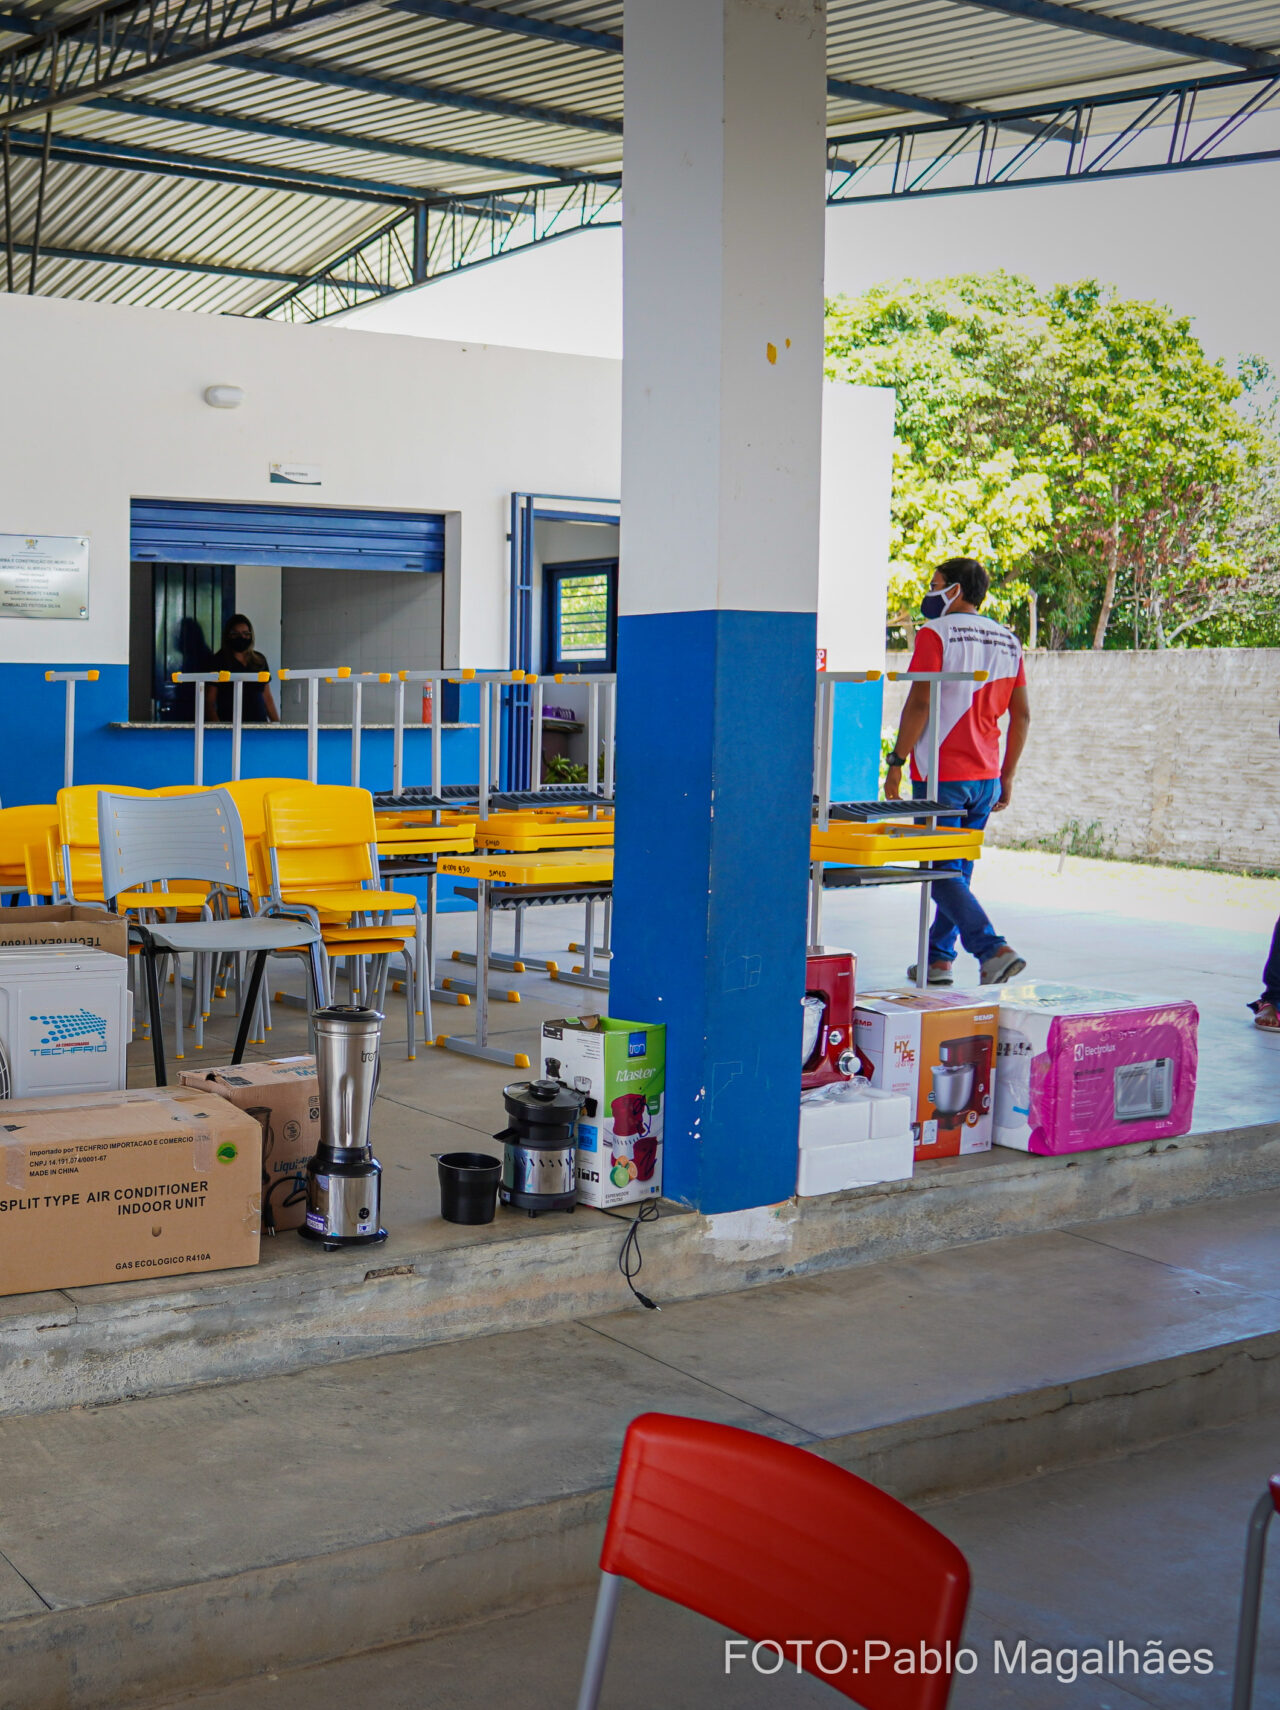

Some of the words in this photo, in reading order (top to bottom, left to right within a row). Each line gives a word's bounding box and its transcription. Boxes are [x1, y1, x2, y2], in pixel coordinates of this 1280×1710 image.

[30, 1044, 107, 1056] TECHFRIO
[1085, 1044, 1116, 1056] Electrolux
[616, 1067, 656, 1083] Master
[63, 1147, 74, 1155] por
[75, 1144, 108, 1152] TECHFRIO
[159, 1136, 194, 1145] COMERCIO
[29, 1169, 49, 1177] MADE
[58, 1166, 79, 1174] CHINA
[0, 1197, 40, 1212] SPLIT
[44, 1194, 80, 1208] TYPE
[86, 1190, 110, 1203] AIR
[114, 1180, 208, 1201] CONDITIONER
[118, 1200, 172, 1216] INDOOR
[175, 1196, 206, 1210] UNIT
[115, 1262, 133, 1270] GAS
[135, 1255, 184, 1268] ECOLOGICO
[186, 1253, 211, 1262] R410A
